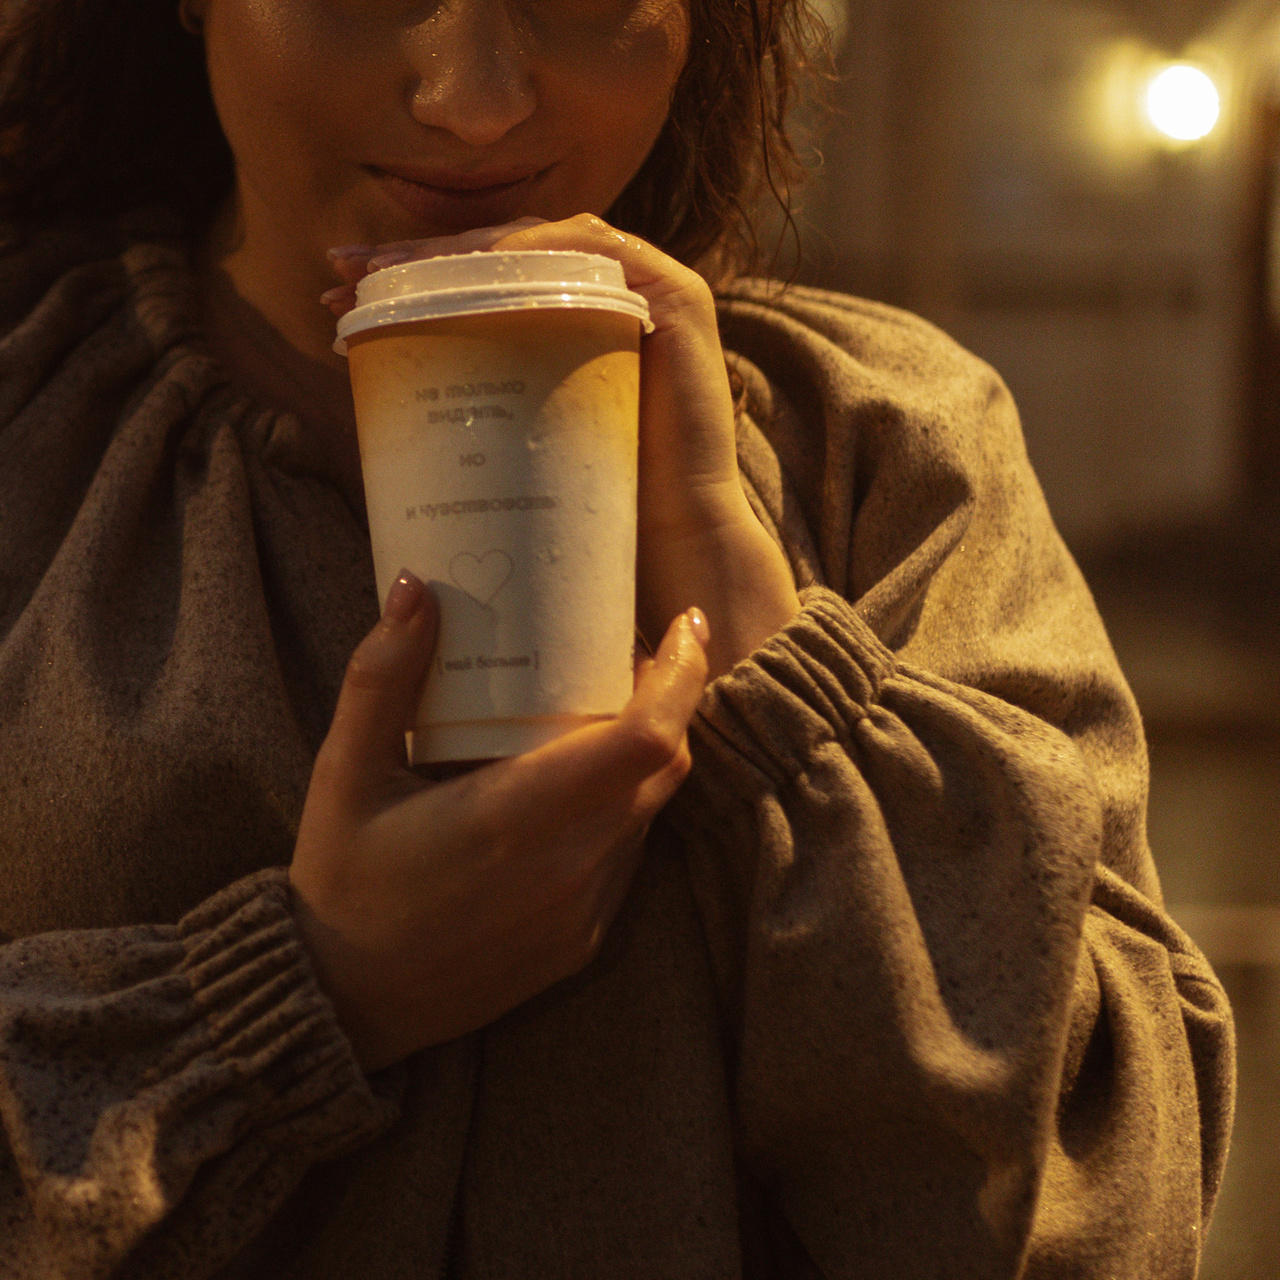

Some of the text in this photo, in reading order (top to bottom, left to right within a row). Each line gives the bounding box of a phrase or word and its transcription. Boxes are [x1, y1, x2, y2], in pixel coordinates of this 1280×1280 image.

[415, 387, 439, 401] не
[459, 452, 487, 467] но
[405, 506, 417, 520] и
